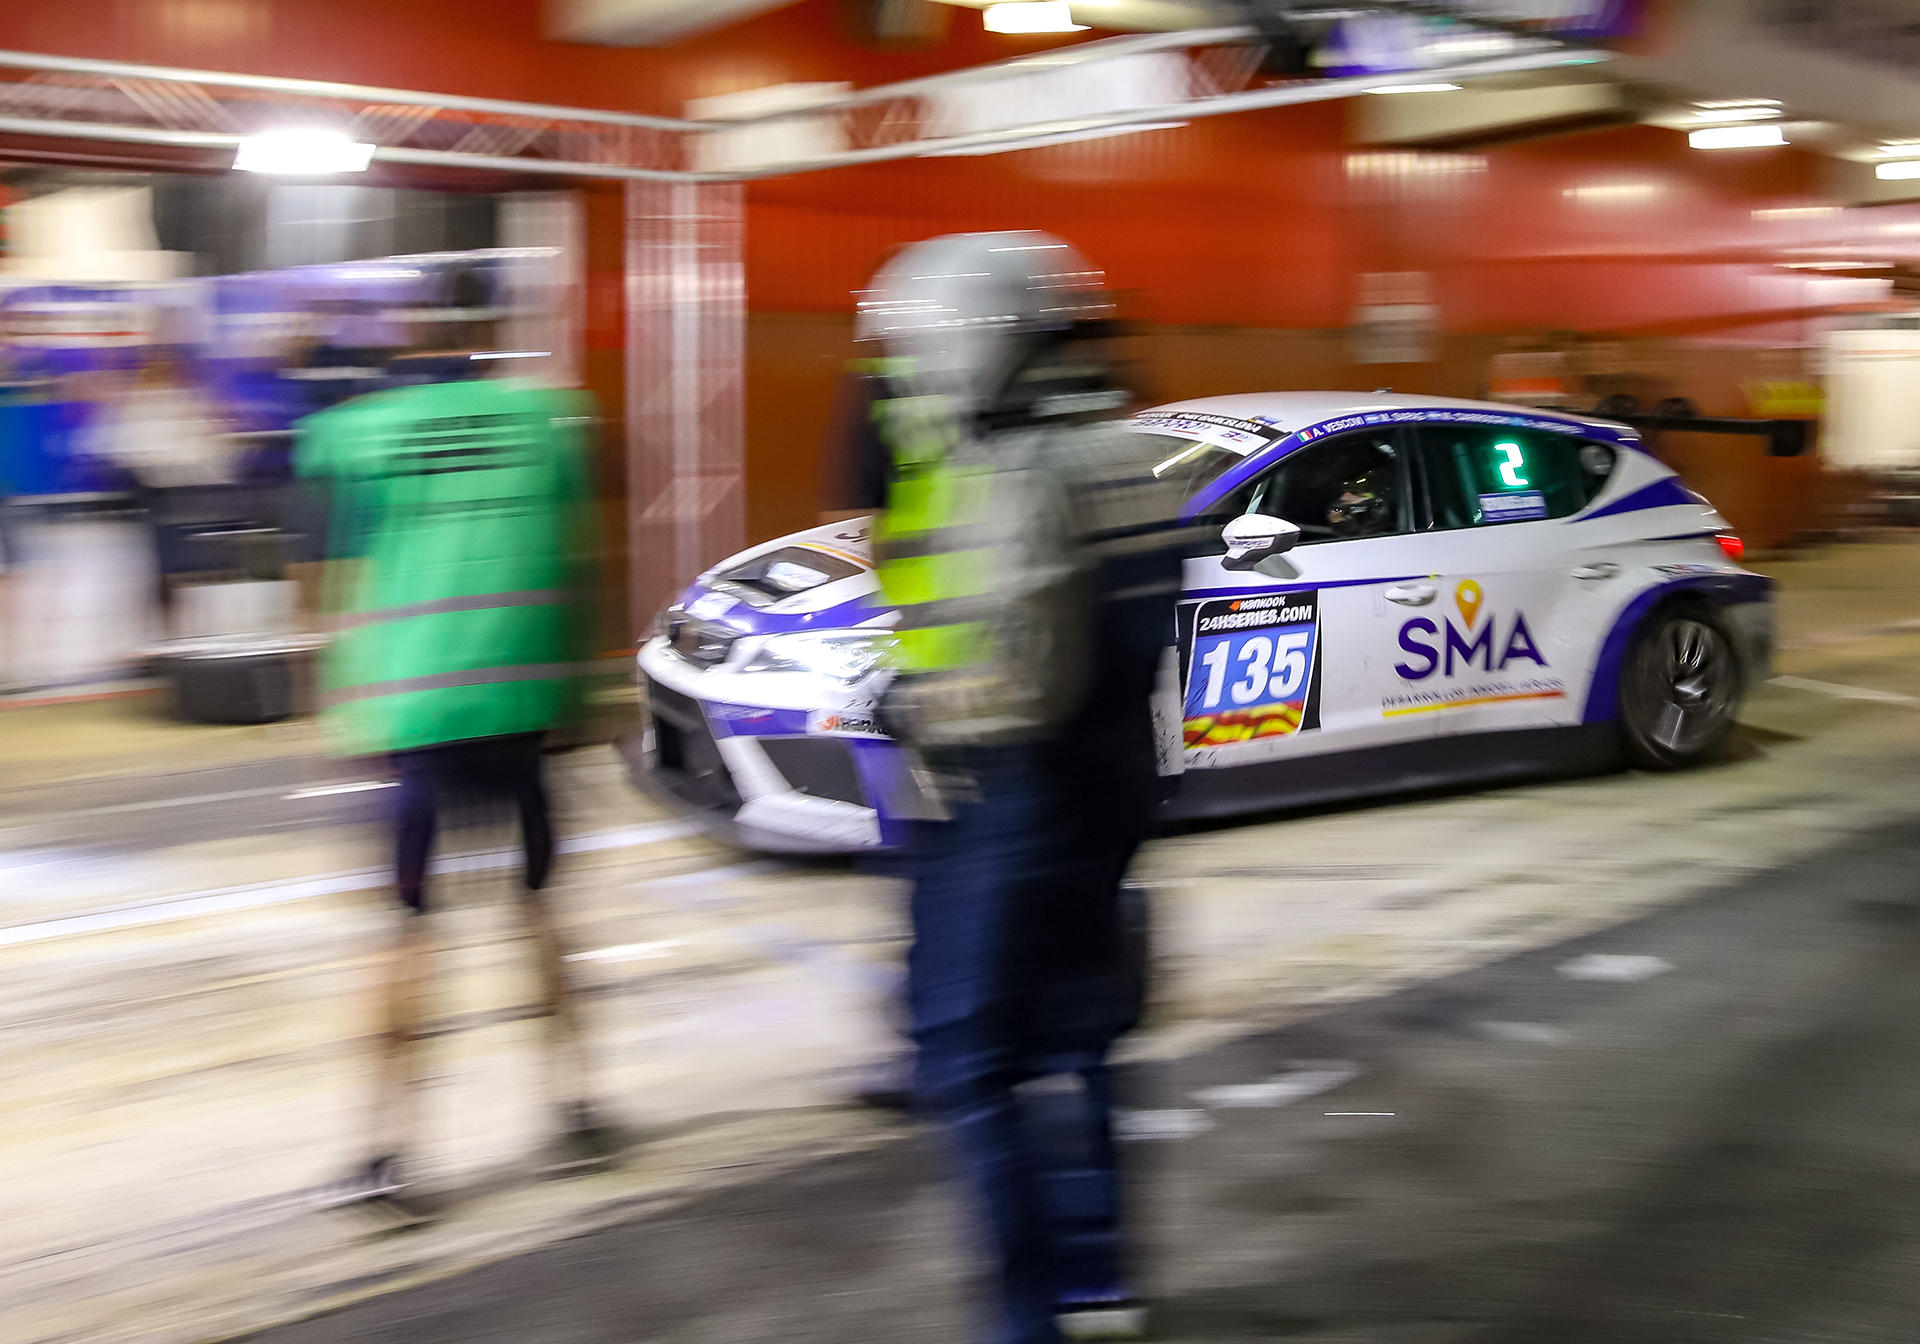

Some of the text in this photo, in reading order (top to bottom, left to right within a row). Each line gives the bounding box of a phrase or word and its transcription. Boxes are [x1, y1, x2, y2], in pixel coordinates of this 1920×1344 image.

[1494, 443, 1528, 486] 2
[1200, 605, 1313, 631] 24HSERIES.COM
[1394, 609, 1552, 680] SMA
[1202, 632, 1309, 709] 135
